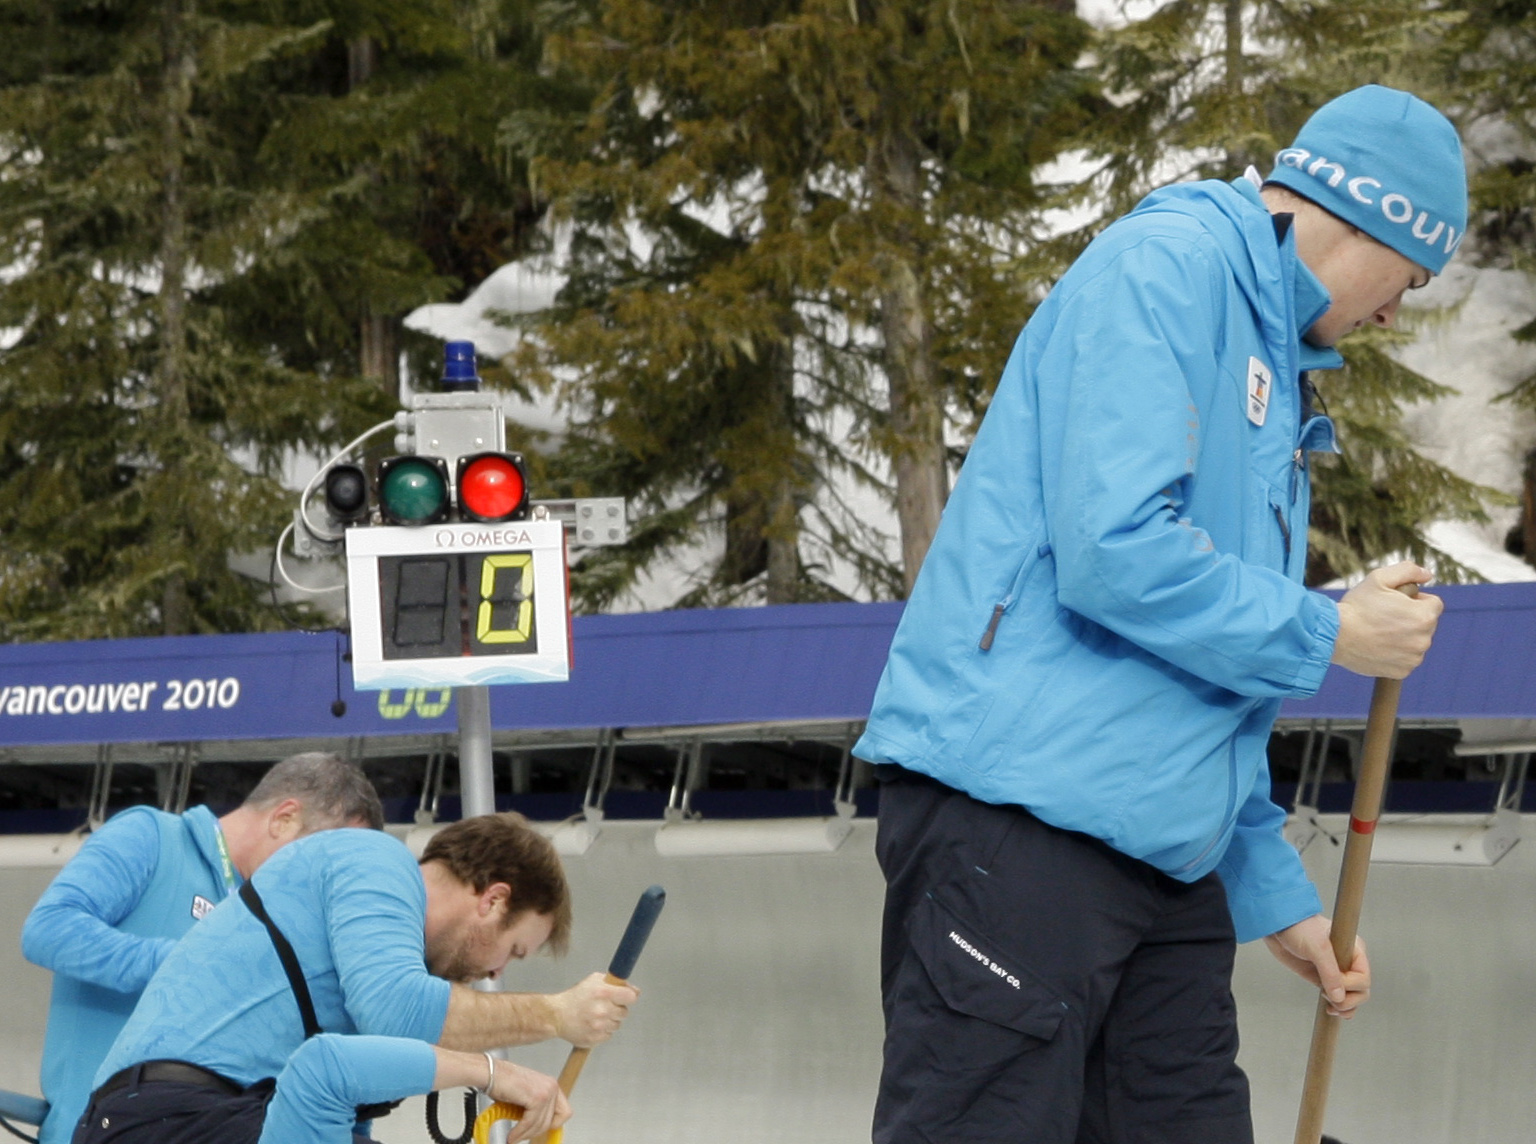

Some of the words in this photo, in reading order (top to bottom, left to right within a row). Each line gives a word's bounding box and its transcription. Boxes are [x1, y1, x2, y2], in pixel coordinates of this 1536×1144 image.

[461, 529, 532, 547] OMEGA
[476, 554, 534, 645] 0
[162, 677, 240, 711] 2010
[949, 931, 990, 967] HUDSON'S
[989, 962, 1008, 978] BAY
[1006, 975, 1021, 990] CO.
